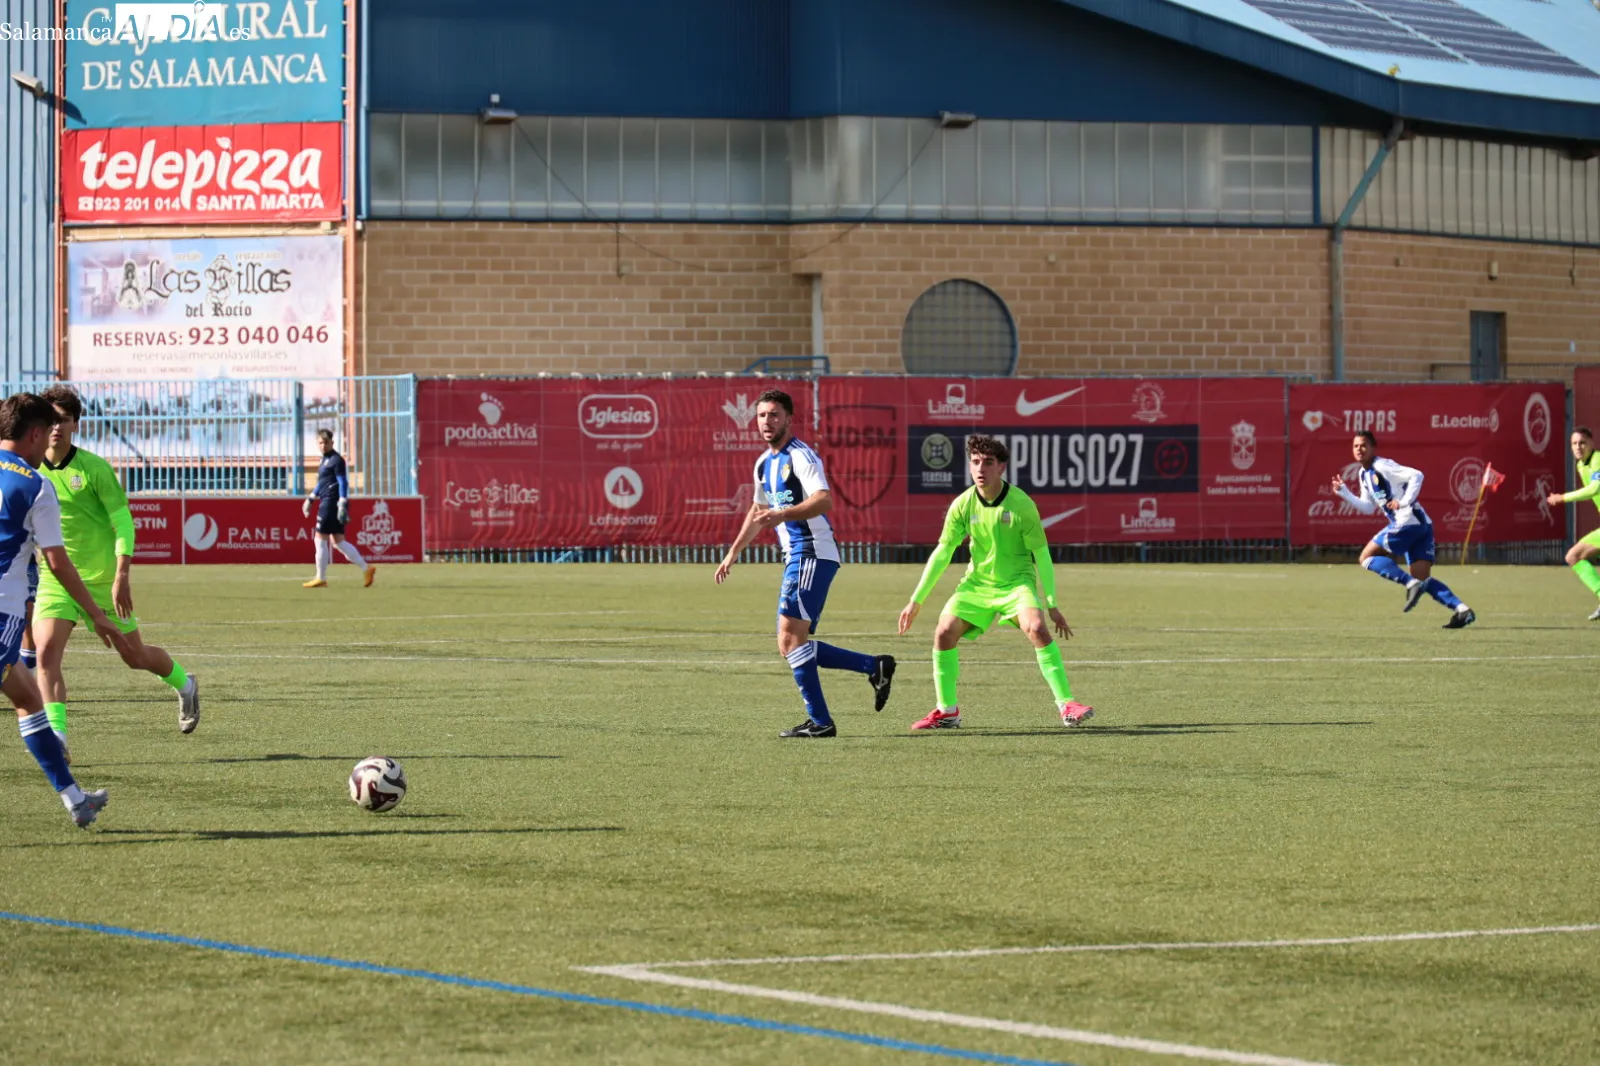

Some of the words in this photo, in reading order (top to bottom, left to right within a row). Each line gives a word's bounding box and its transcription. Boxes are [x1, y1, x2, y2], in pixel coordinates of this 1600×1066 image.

[82, 60, 121, 90] DE
[129, 52, 327, 88] SALAMANCA
[79, 137, 322, 210] telepizza
[94, 196, 120, 211] 923
[124, 196, 150, 211] 201
[155, 195, 180, 211] 014
[196, 194, 256, 211] SANTA
[261, 193, 324, 209] MARTA
[147, 260, 201, 298] Las
[185, 302, 203, 317] del
[93, 331, 183, 347] RESERVAS:
[188, 326, 229, 346] 923
[238, 326, 279, 345] 040
[287, 325, 328, 344] 046
[1343, 410, 1397, 432] TAPAS
[827, 425, 897, 449] UDSM
[133, 516, 167, 529] STIN
[357, 530, 402, 545] SPORT
